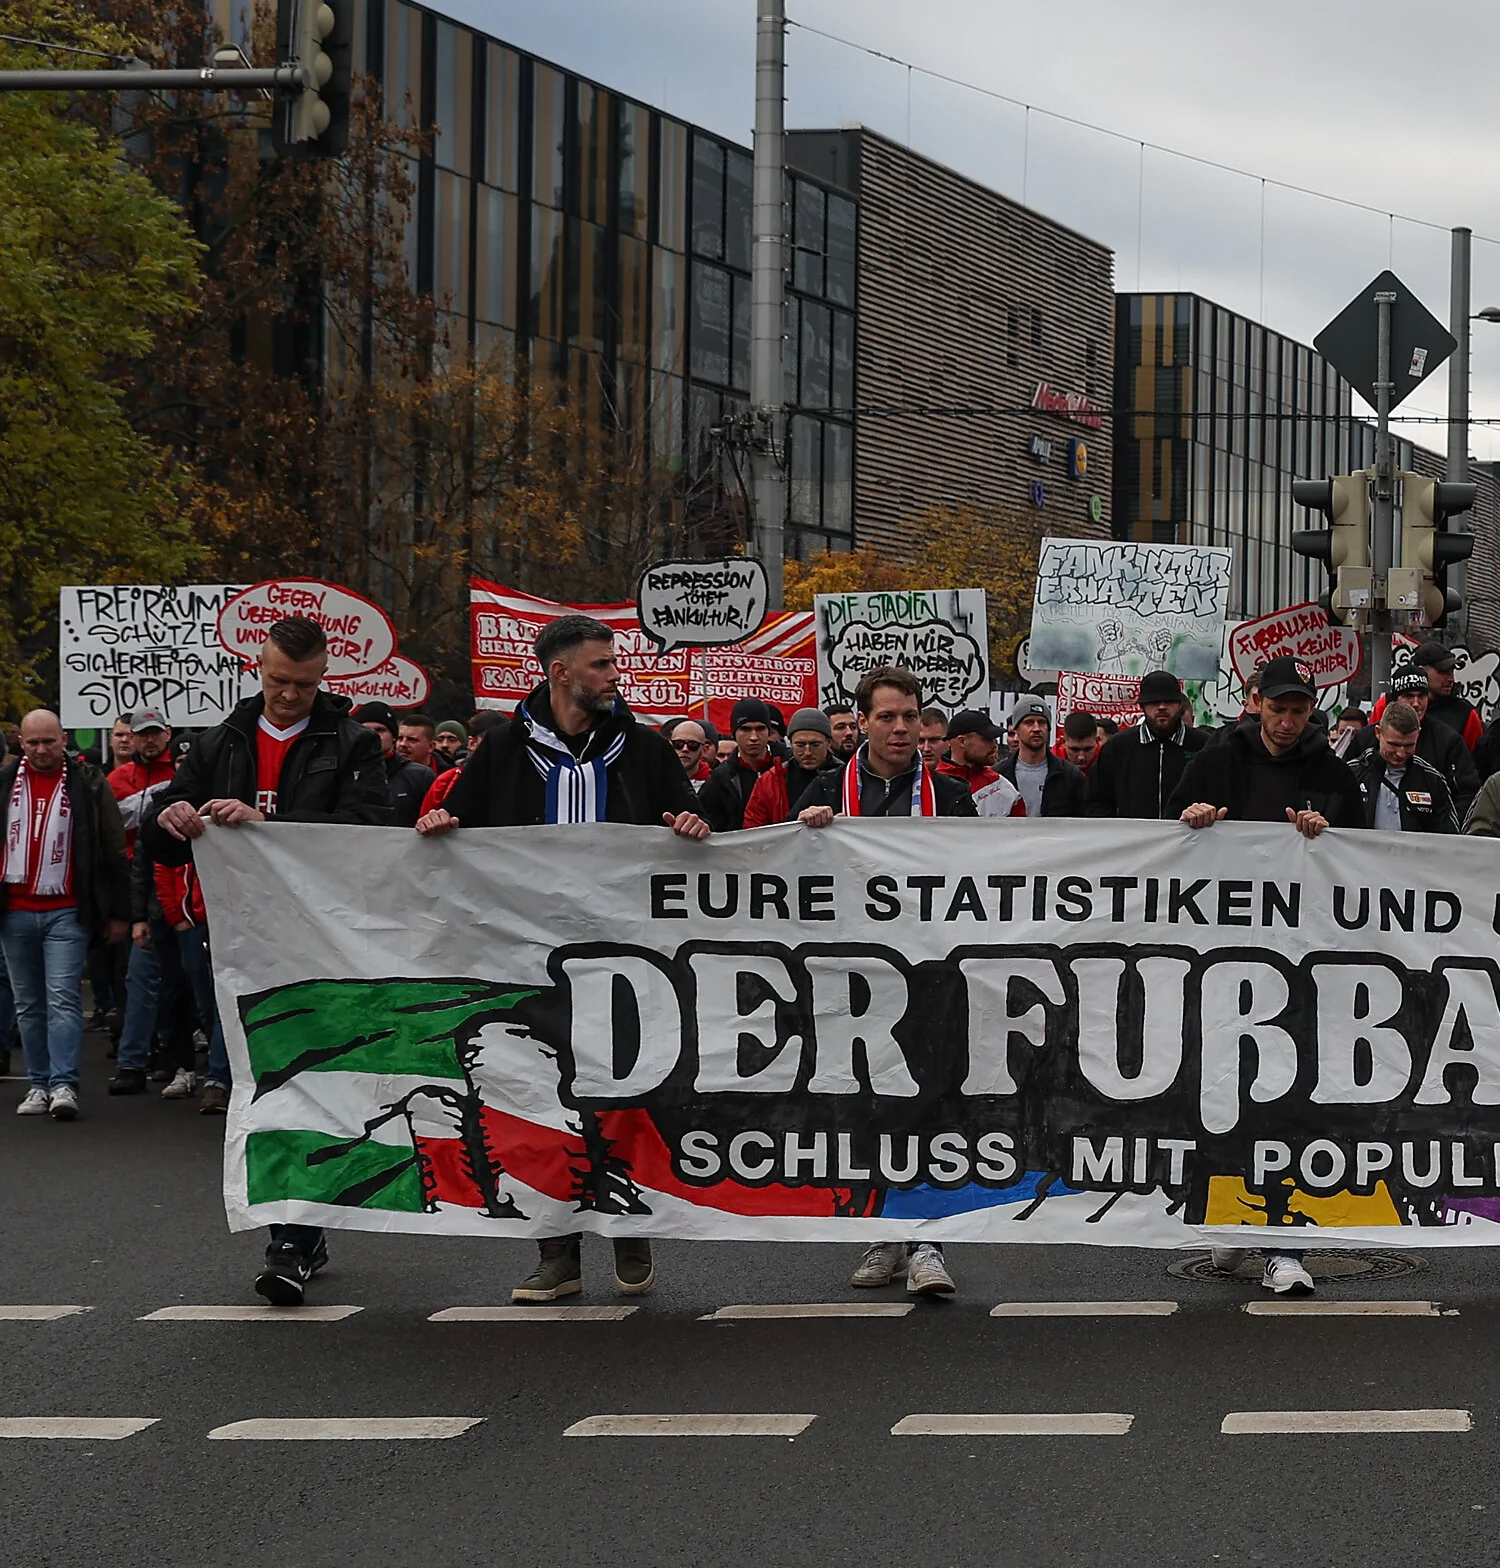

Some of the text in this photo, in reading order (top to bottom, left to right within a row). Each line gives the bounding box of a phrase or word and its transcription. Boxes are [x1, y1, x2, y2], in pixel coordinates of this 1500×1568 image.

[1039, 544, 1231, 587] FANKULTUR
[267, 583, 327, 611] GEGEN
[1038, 575, 1218, 617] ERHALTEN
[652, 597, 757, 631] FANKULTUR!
[236, 627, 270, 645] UND
[845, 632, 909, 652] HABEN
[1237, 610, 1329, 656] FUßBALLFAN
[480, 638, 683, 670] HERZE URVEN
[690, 655, 816, 673] MENTSVERBOTE
[894, 652, 975, 677] ANDEREN
[1306, 641, 1354, 676] ECHER!
[328, 677, 420, 700] FANKULTUR!
[484, 668, 545, 691] KALT
[690, 670, 802, 686] INGELEITETEN
[1061, 675, 1137, 702] SICHE
[688, 684, 803, 701] ERSUCHUNGEN
[649, 873, 835, 922] EURE
[864, 873, 1300, 927] STATISTIKEN
[1332, 885, 1463, 933] UND
[561, 953, 920, 1098] DER
[679, 1129, 1017, 1182] SCHLUSS
[1071, 1134, 1197, 1185] MIT
